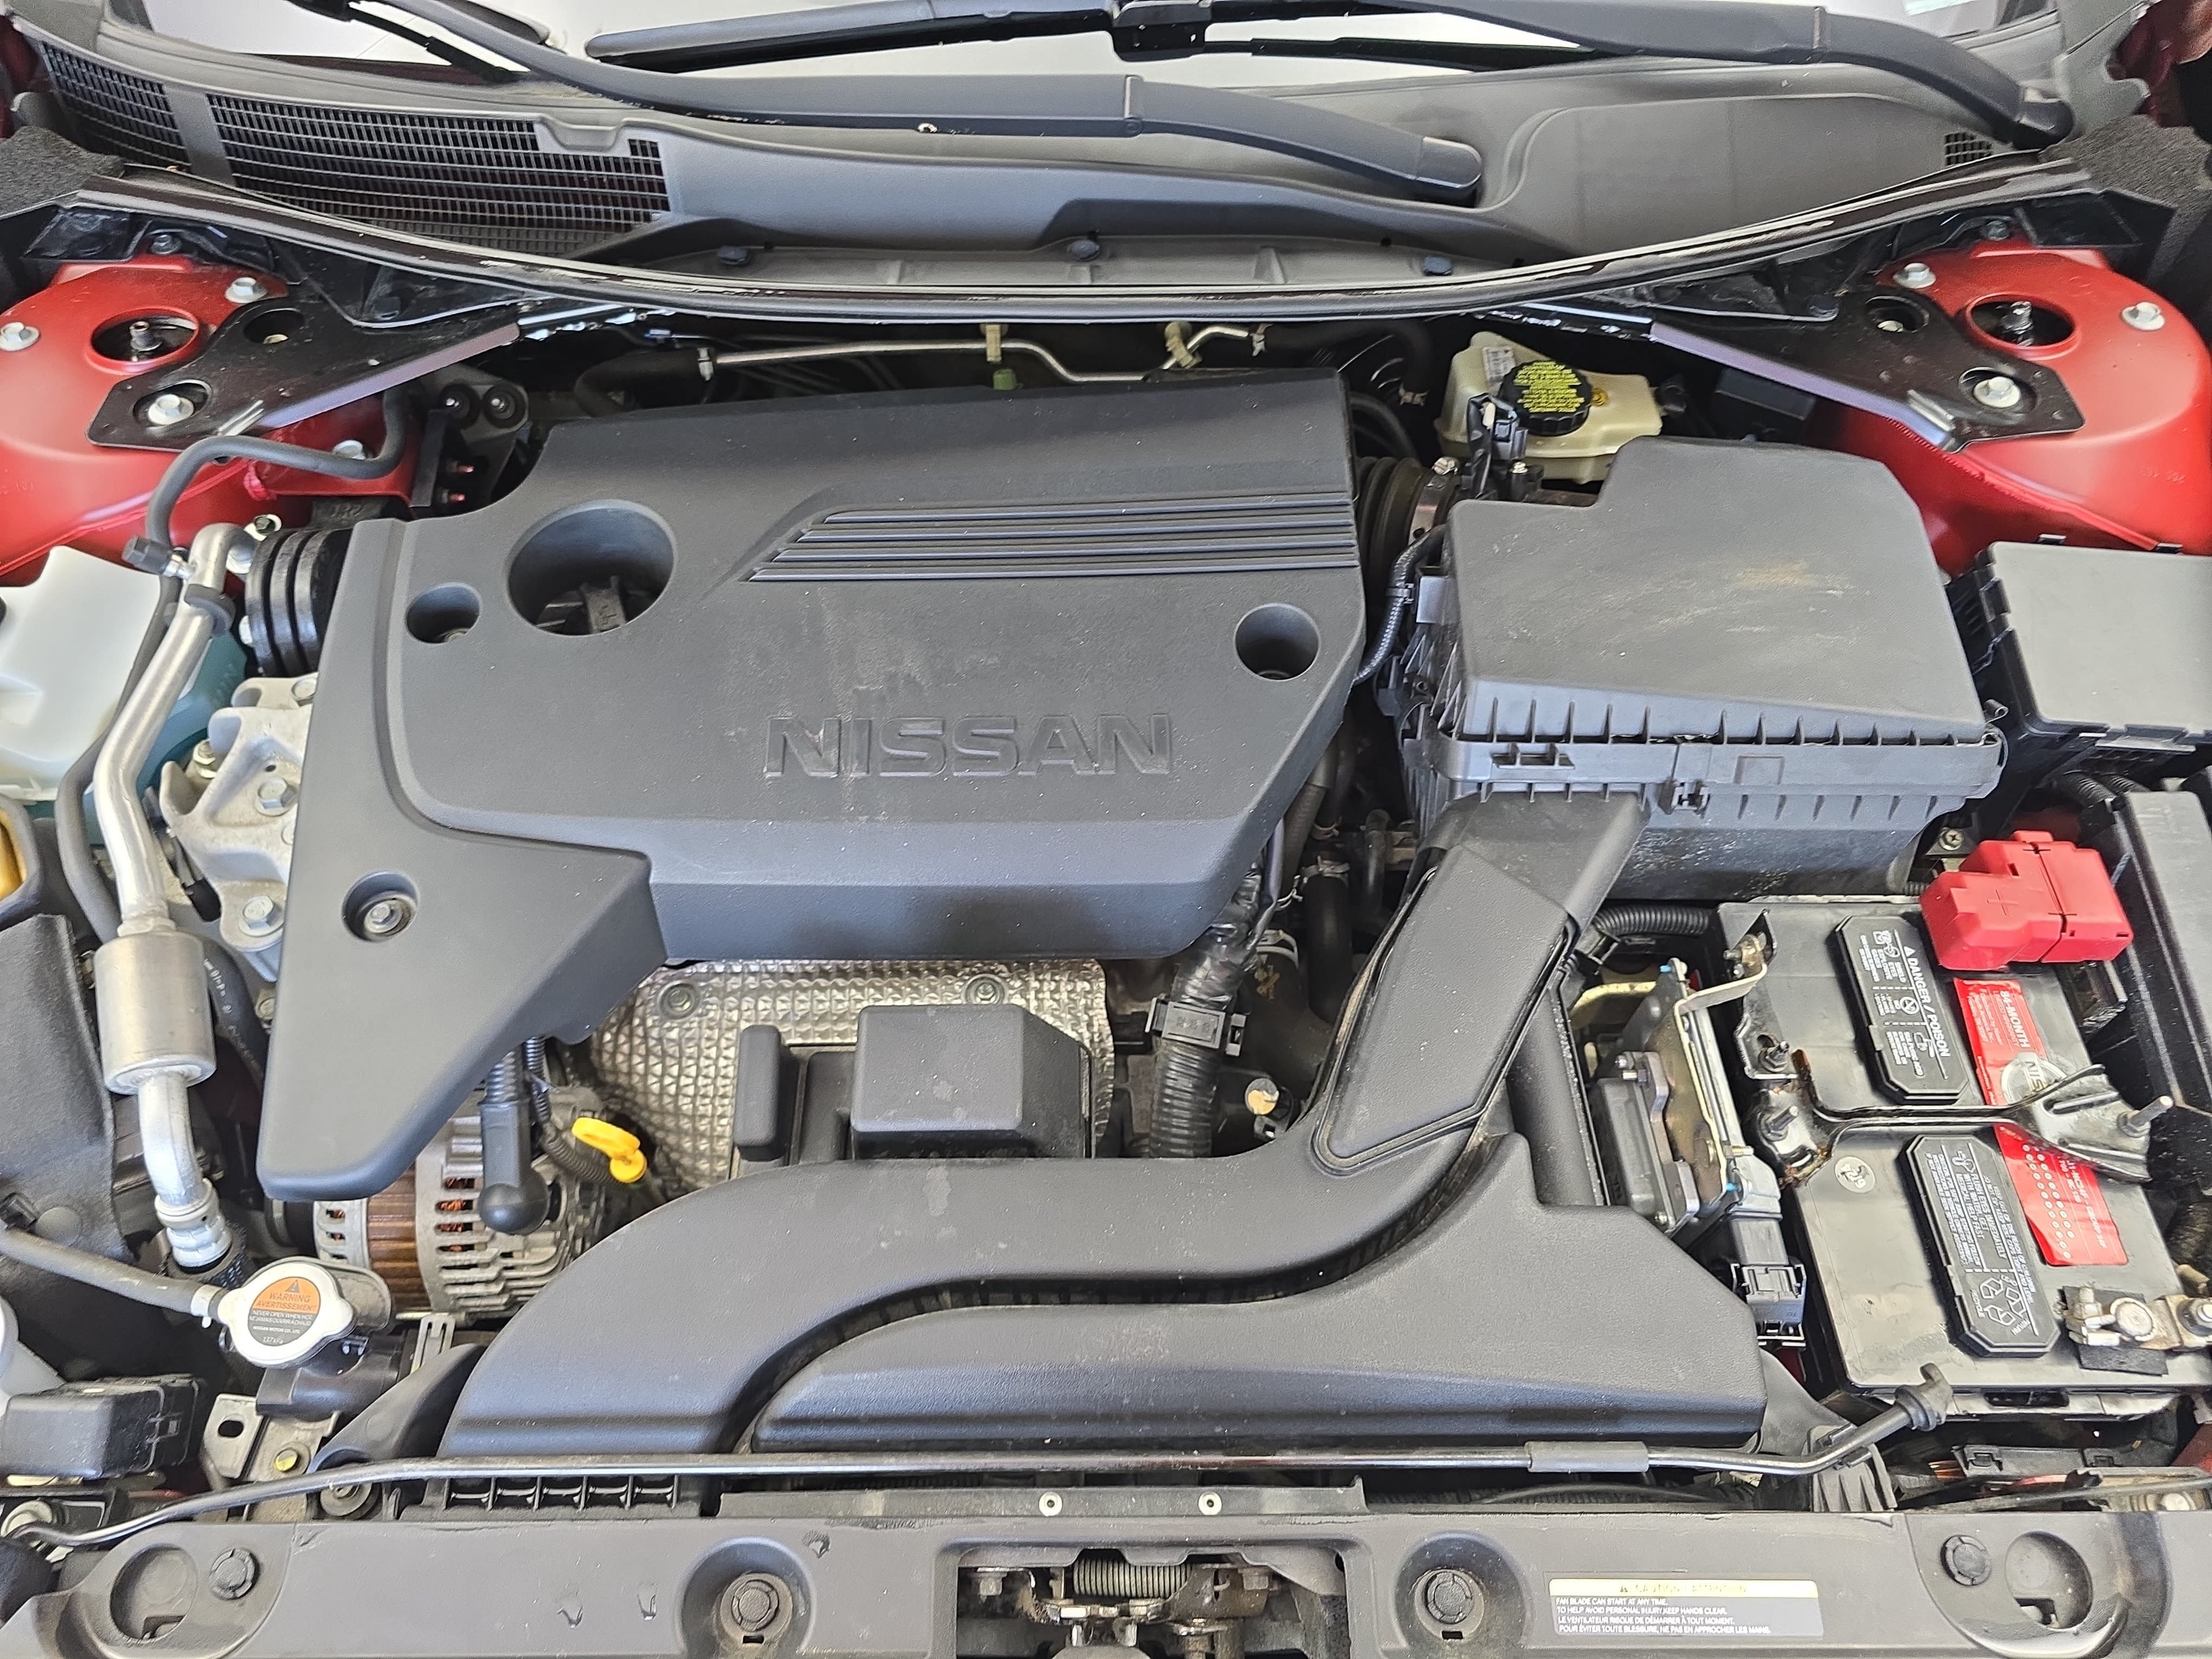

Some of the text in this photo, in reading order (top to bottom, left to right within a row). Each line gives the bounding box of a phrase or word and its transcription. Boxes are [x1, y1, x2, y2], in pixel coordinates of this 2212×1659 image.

[764, 713, 1172, 779] NISSAN
[1907, 957, 1932, 1002] DANGER
[1926, 1014, 1950, 1057] POISON
[1999, 991, 2030, 1048] 84-MONTH
[1913, 1061, 1923, 1076] ACID
[1955, 1174, 1984, 1238] MEDICAL HELP FAST
[1963, 1174, 1975, 1190] WITH
[1978, 1218, 1989, 1231] GET
[1970, 1173, 2007, 1258] FLUSH EYES IMMEDIATELY
[1993, 1186, 2003, 1199] KEEP
[1998, 1201, 2008, 1212] OUT
[2003, 1214, 2011, 1222] OF
[2017, 1255, 2025, 1263] OF
[255, 1300, 317, 1311] AVERTISSEMENT
[269, 1292, 311, 1303] WARNING
[1556, 1597, 1569, 1605] FAN
[1570, 1597, 1591, 1605] BLADE
[1558, 1616, 1566, 1624] LE
[1567, 1616, 1609, 1624] VENTILATEUR
[1609, 1616, 1634, 1624] RISQUE
[1634, 1616, 1644, 1624] DE
[1688, 1617, 1704, 1625] TOUT
